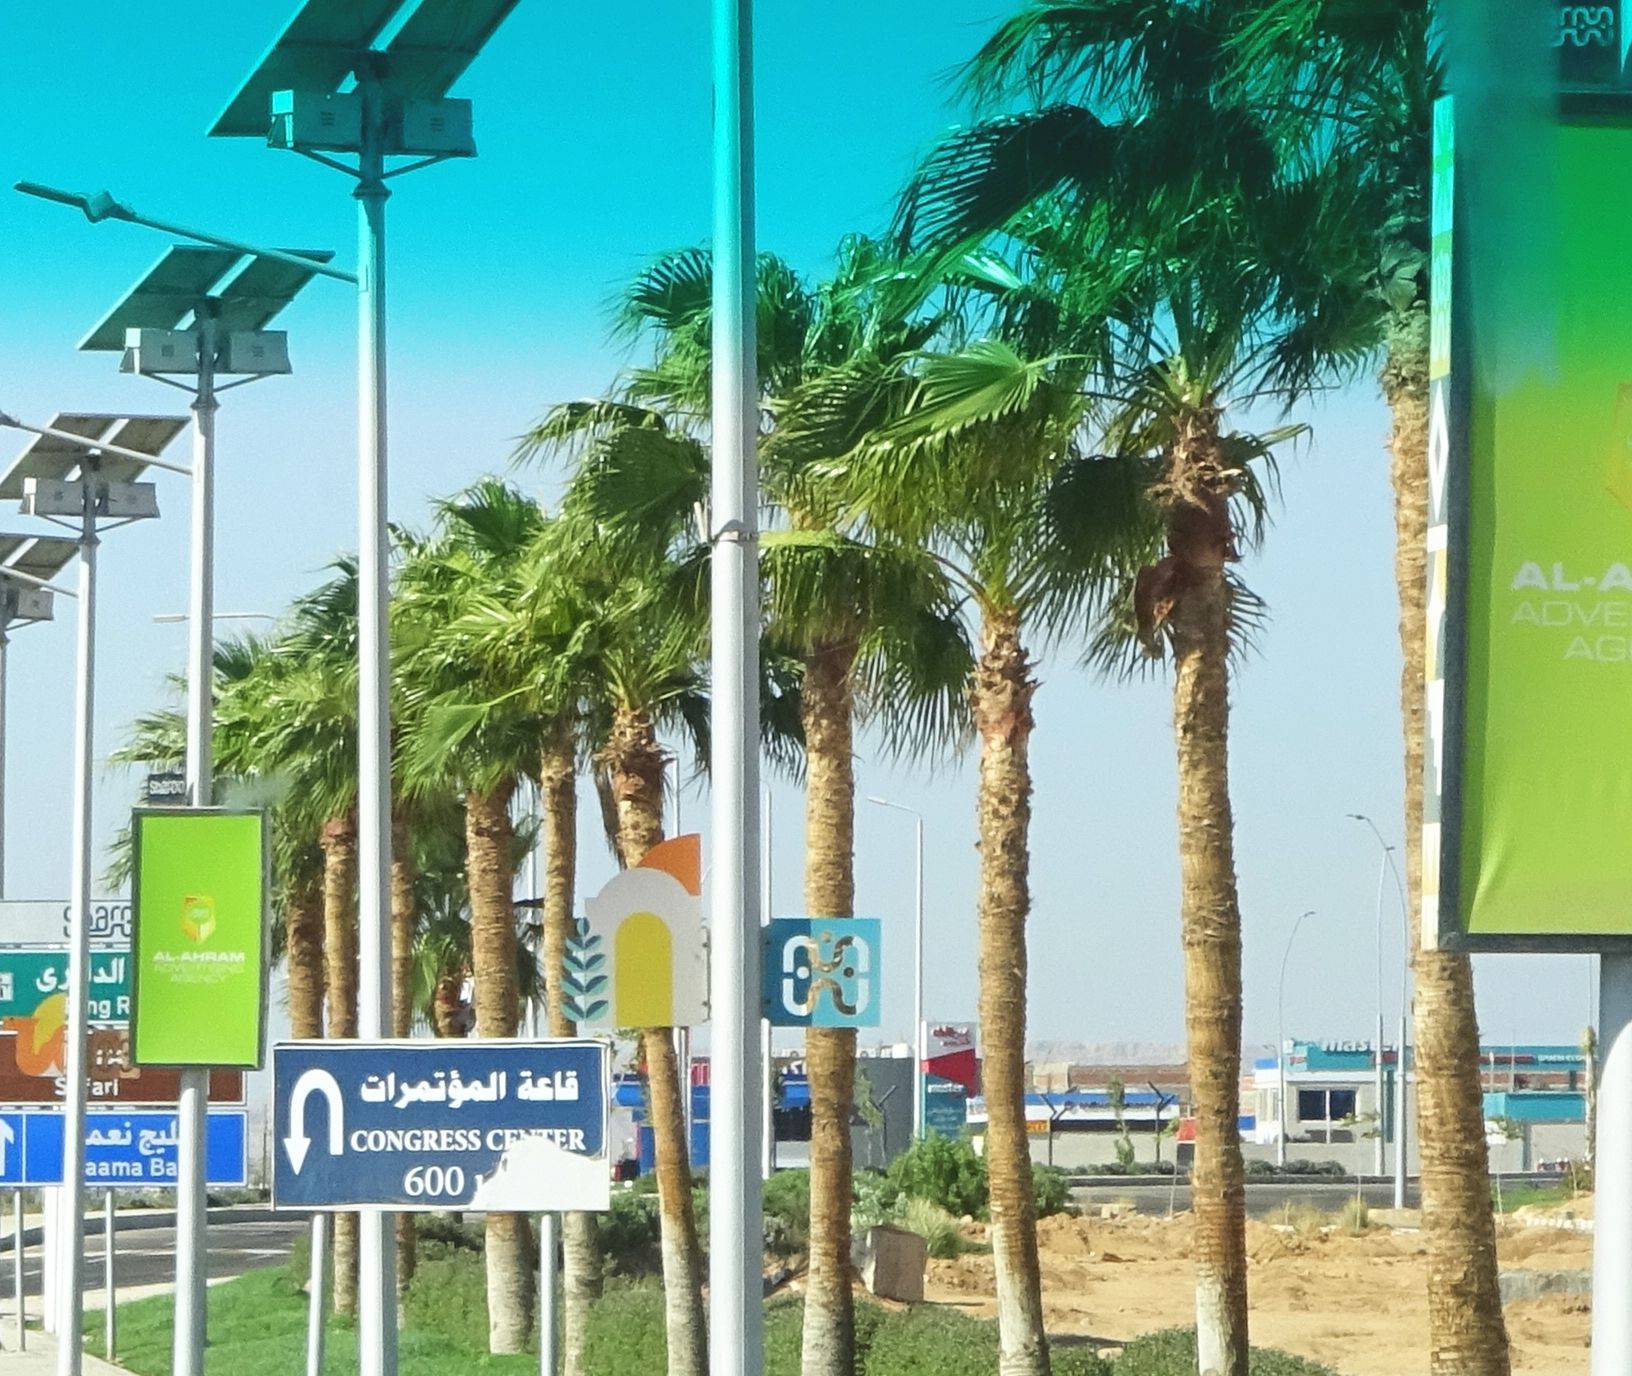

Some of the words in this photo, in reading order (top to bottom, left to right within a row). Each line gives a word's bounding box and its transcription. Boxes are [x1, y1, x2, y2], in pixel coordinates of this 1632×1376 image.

[1563, 635, 1632, 662] AG
[153, 951, 245, 962] AL-AHRAM
[54, 1078, 119, 1097] Sari
[360, 1070, 507, 1109] المؤتمرات
[517, 1070, 579, 1101] قاعة
[86, 1120, 133, 1147] نعم
[350, 1129, 483, 1152] CONGRESS
[86, 1161, 144, 1177] aama
[150, 1157, 179, 1177] Ba
[403, 1166, 466, 1196] 600
